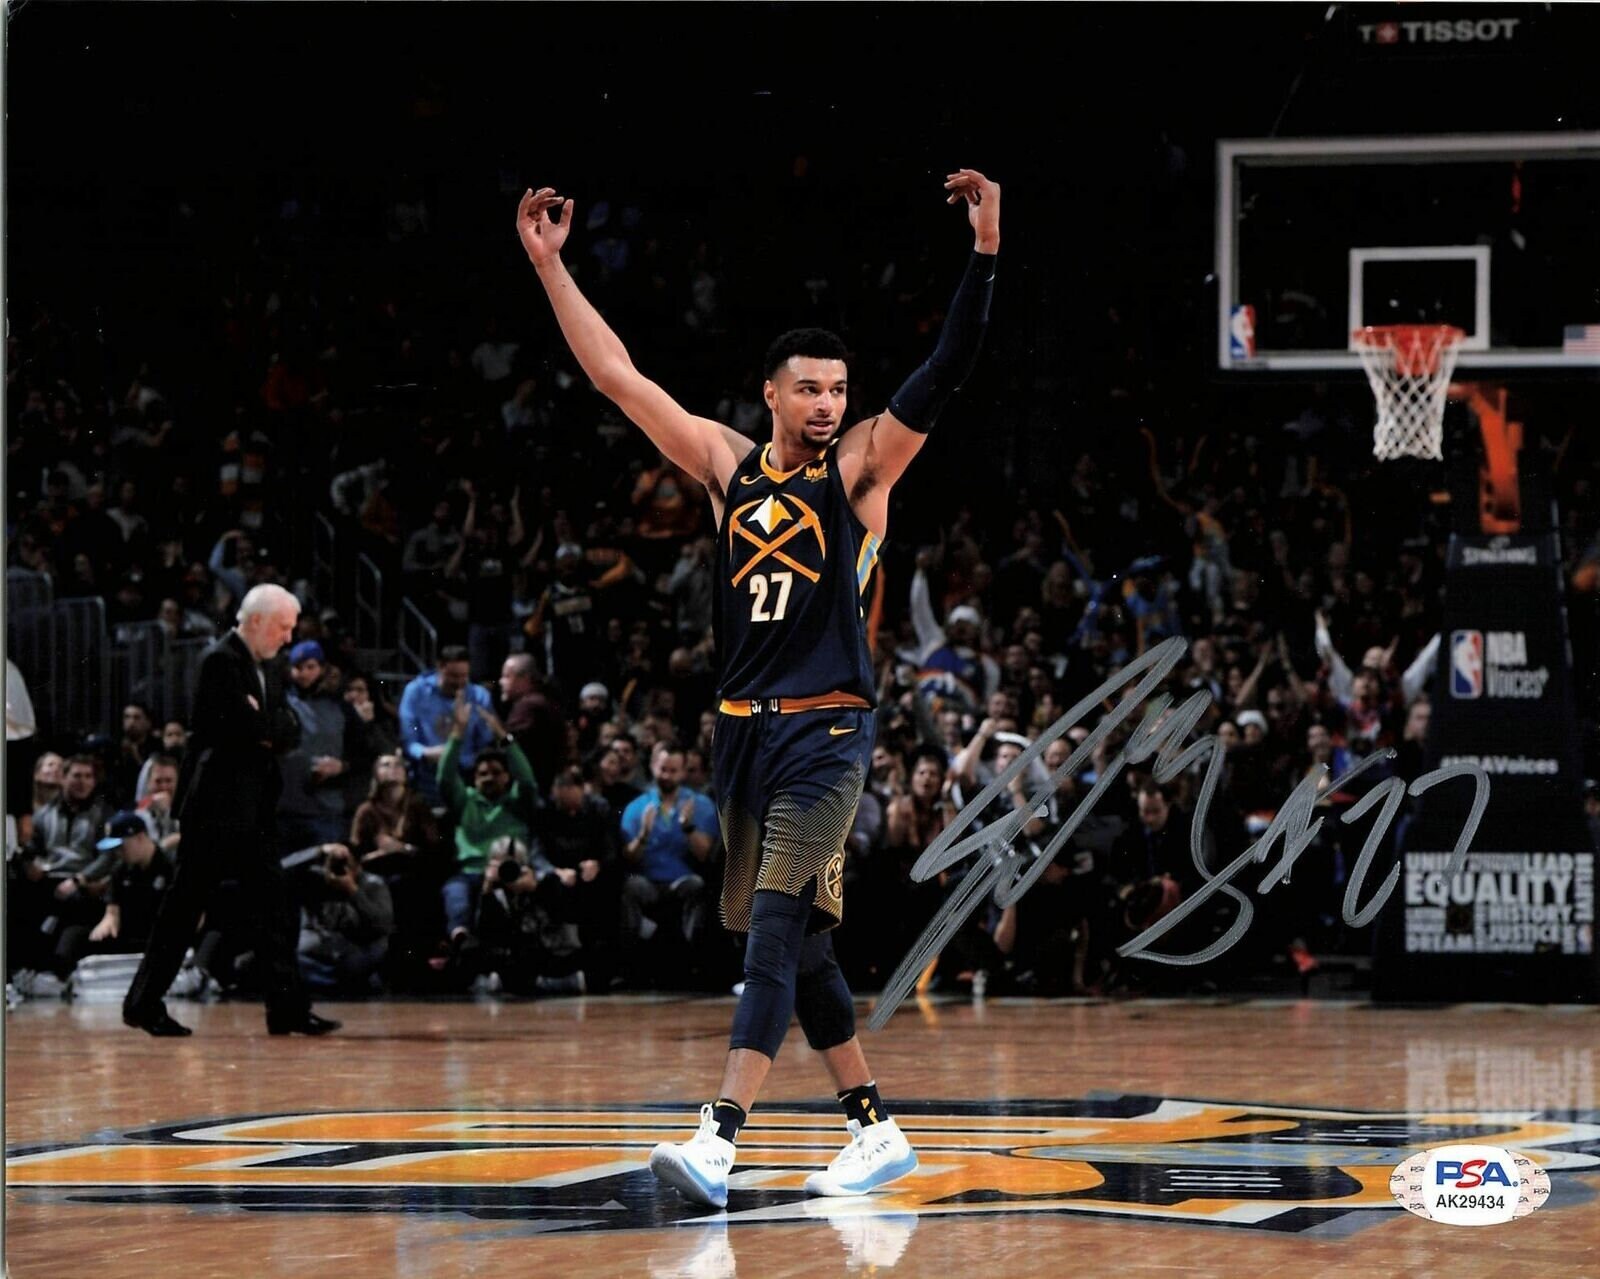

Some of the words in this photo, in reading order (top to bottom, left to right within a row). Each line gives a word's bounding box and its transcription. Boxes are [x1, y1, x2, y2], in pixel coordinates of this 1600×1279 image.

[1402, 18, 1519, 42] TISSOT
[750, 571, 793, 623] 27
[1405, 872, 1573, 907] EQUALITY
[1436, 1194, 1505, 1209] AK29434
